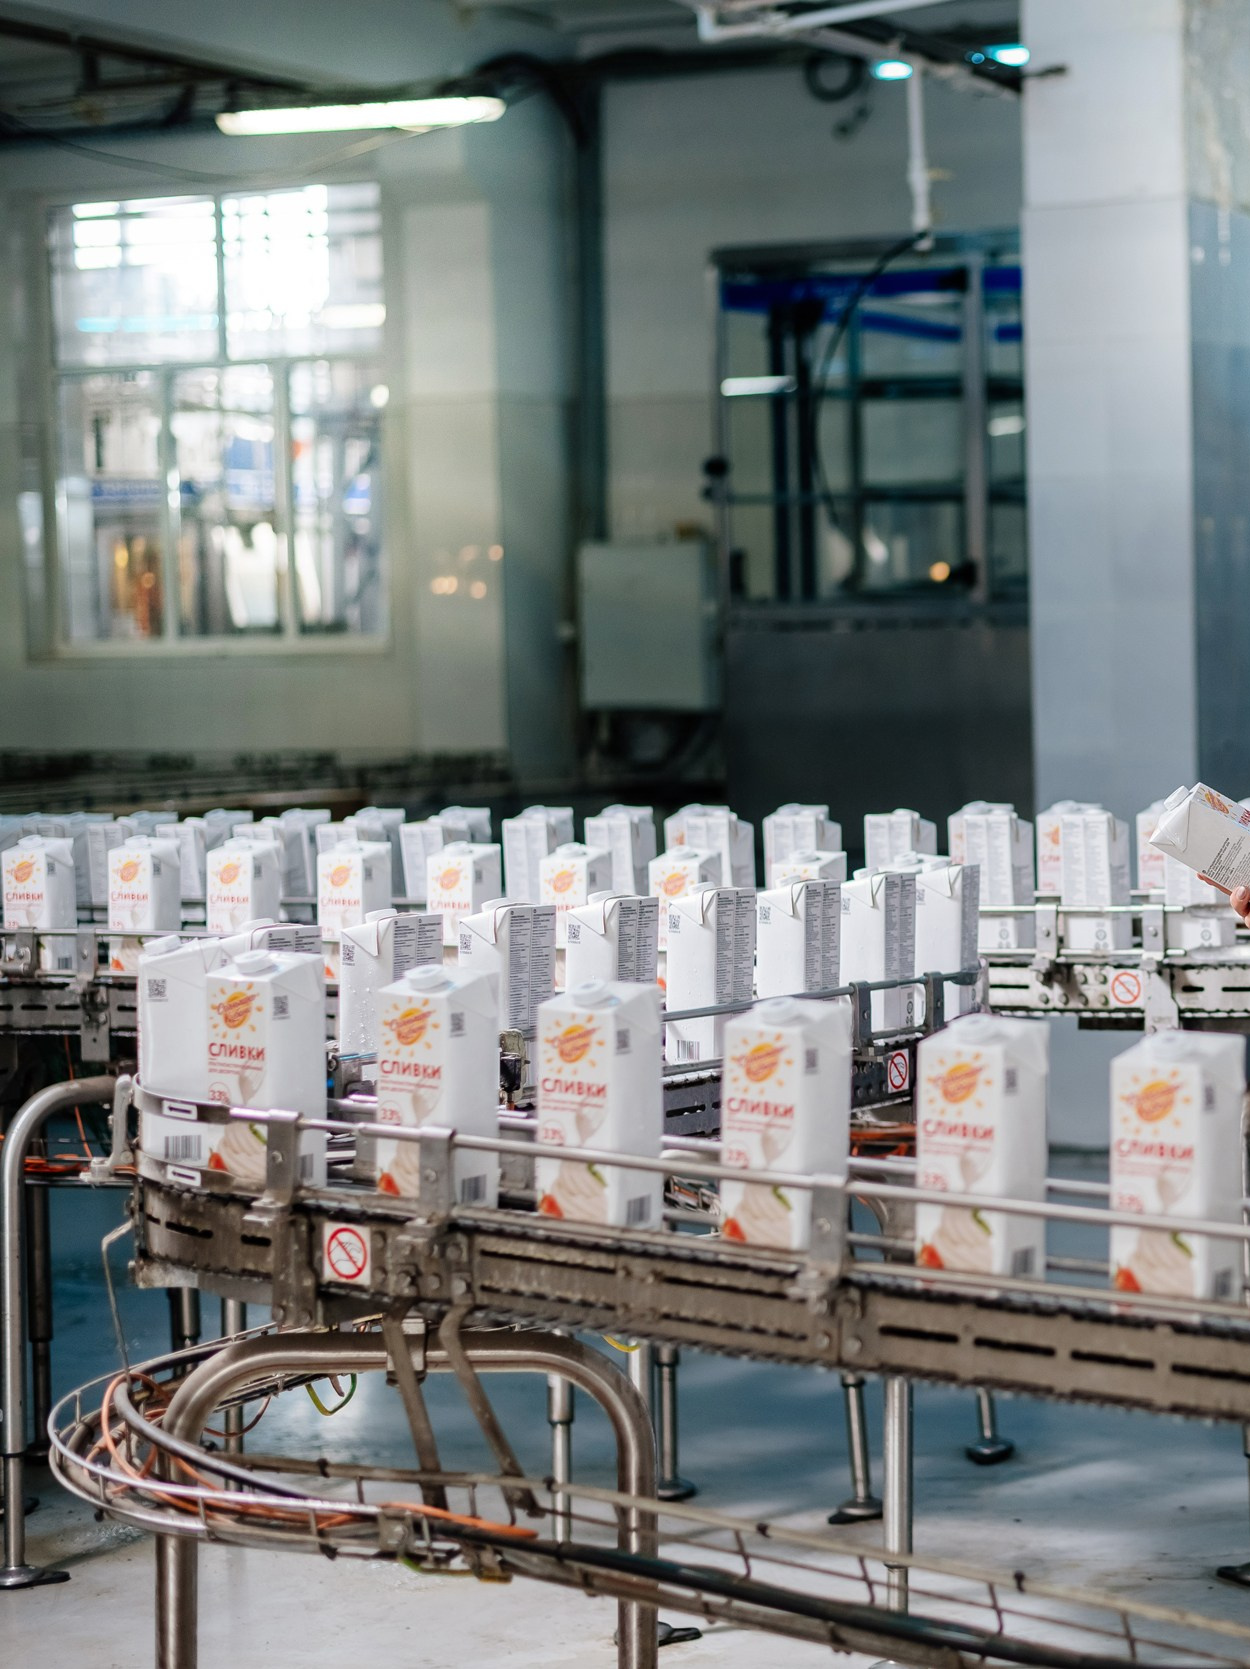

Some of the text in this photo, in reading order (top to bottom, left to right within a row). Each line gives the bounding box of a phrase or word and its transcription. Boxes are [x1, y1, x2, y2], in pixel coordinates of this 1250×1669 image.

[208, 1042, 265, 1061] СЛИВКИ
[380, 1059, 442, 1080] СЛИВКИ
[541, 1077, 607, 1098] СЛИВКИ
[727, 1097, 795, 1119] СЛИВКИ
[922, 1119, 995, 1140] СЛИВКИ
